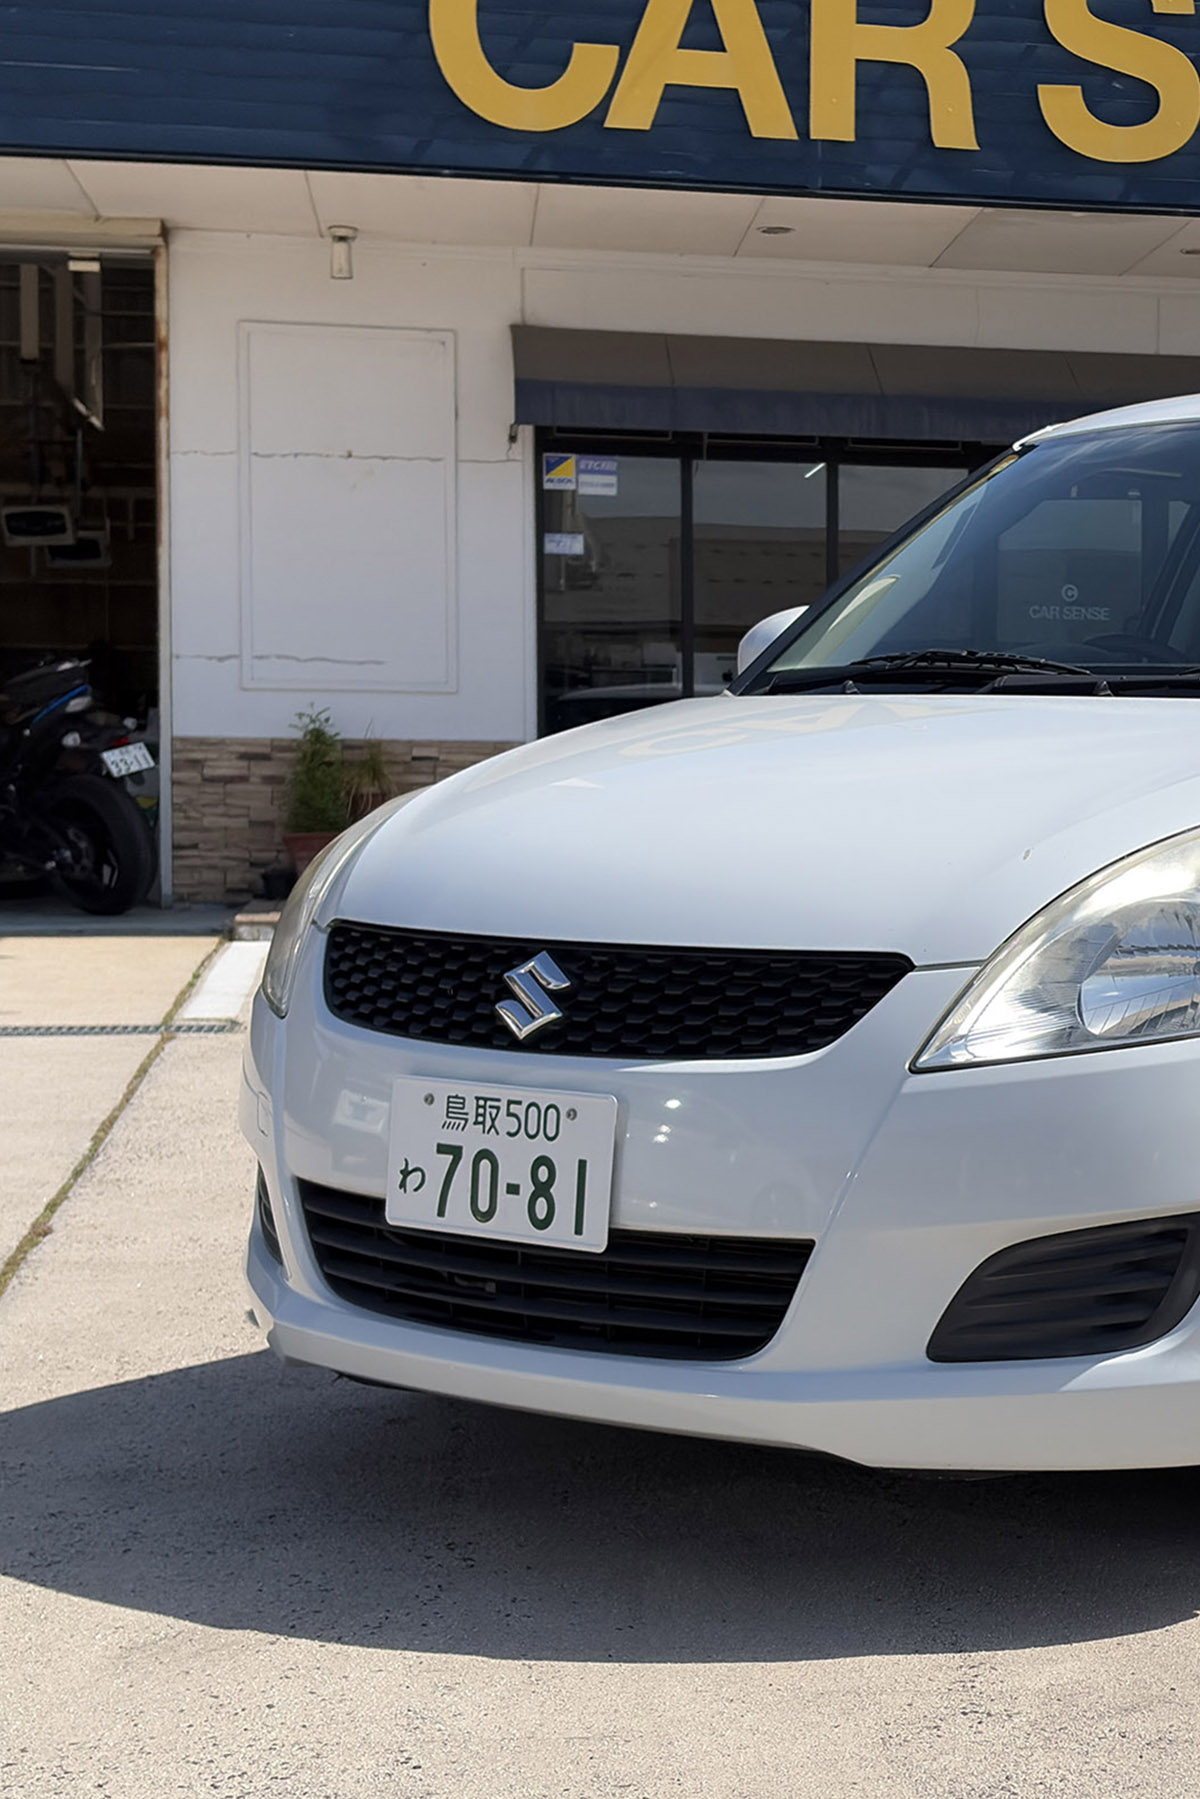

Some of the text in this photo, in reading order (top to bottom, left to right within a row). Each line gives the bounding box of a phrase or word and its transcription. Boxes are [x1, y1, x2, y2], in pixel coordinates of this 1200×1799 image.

[428, 0, 981, 150] CAR
[1028, 605, 1111, 621] CAR SENSE
[441, 1093, 561, 1142] 鳥取500
[398, 1142, 588, 1236] わ 70-81
